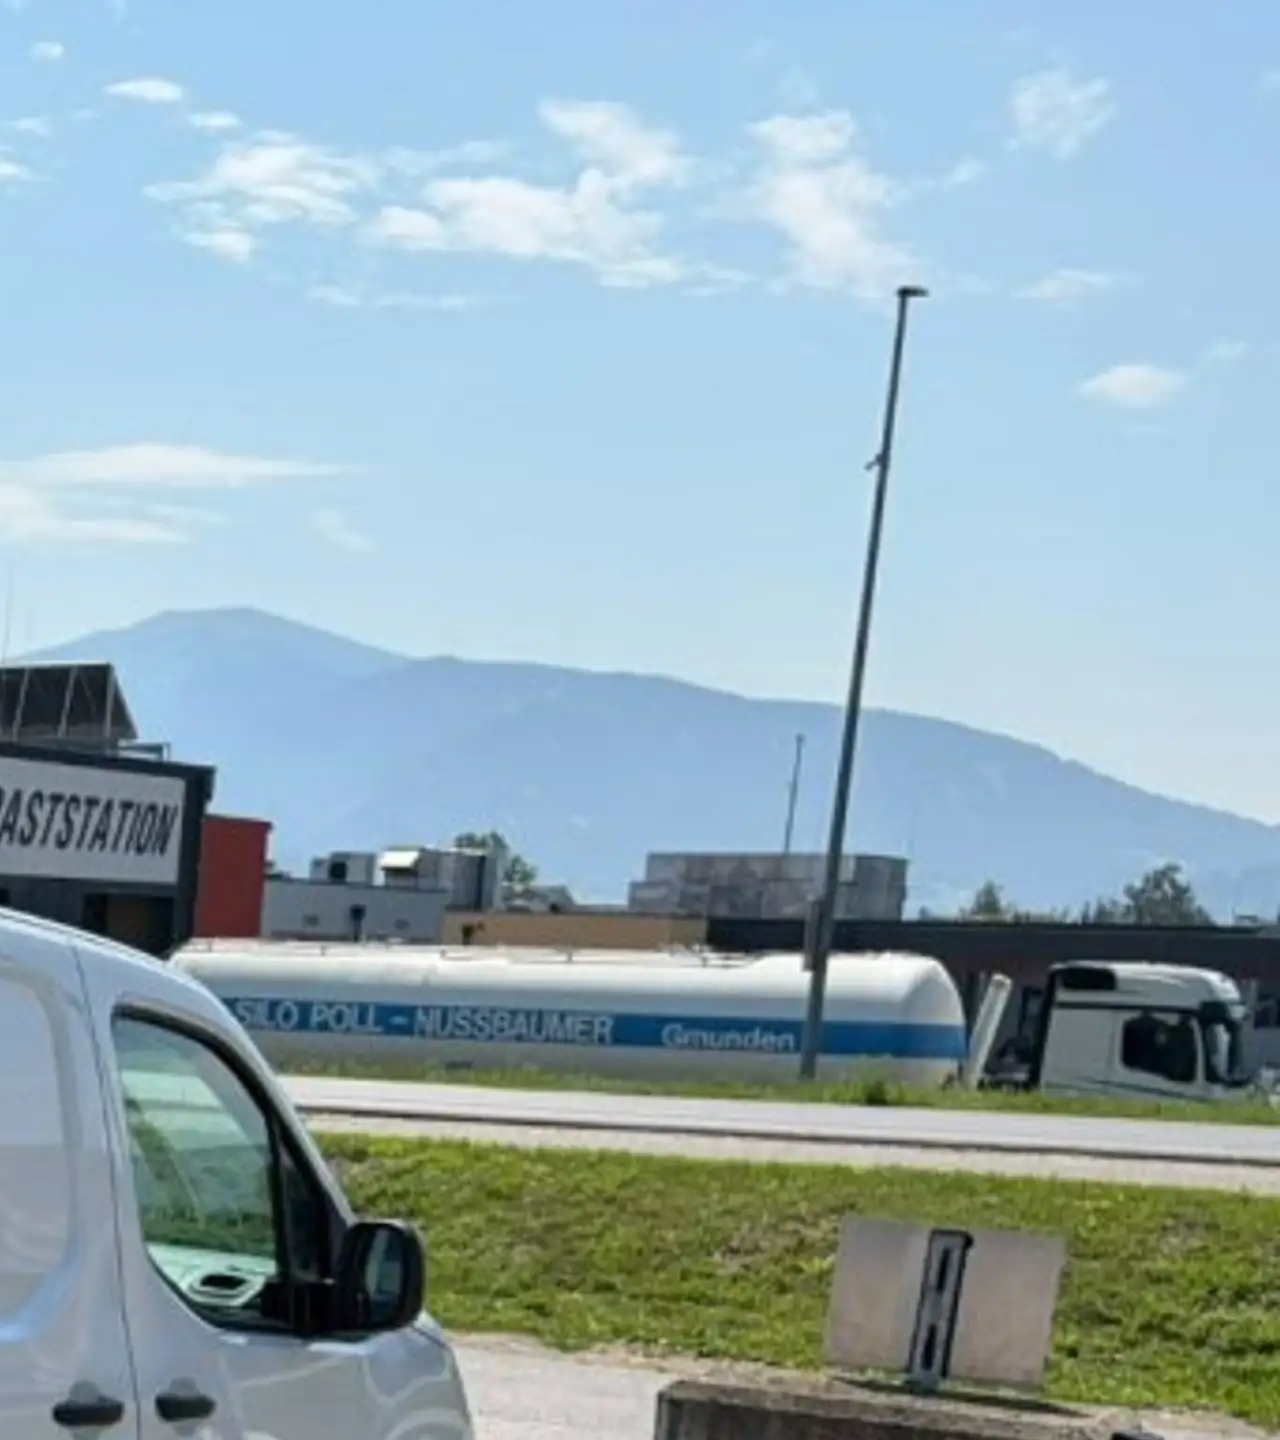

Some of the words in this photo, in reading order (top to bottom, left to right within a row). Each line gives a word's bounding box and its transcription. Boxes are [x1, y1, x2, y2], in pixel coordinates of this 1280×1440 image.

[309, 1001, 384, 1034] POLL
[413, 1006, 615, 1046] NUSSBAUMER
[660, 1023, 796, 1054] Gmunden
